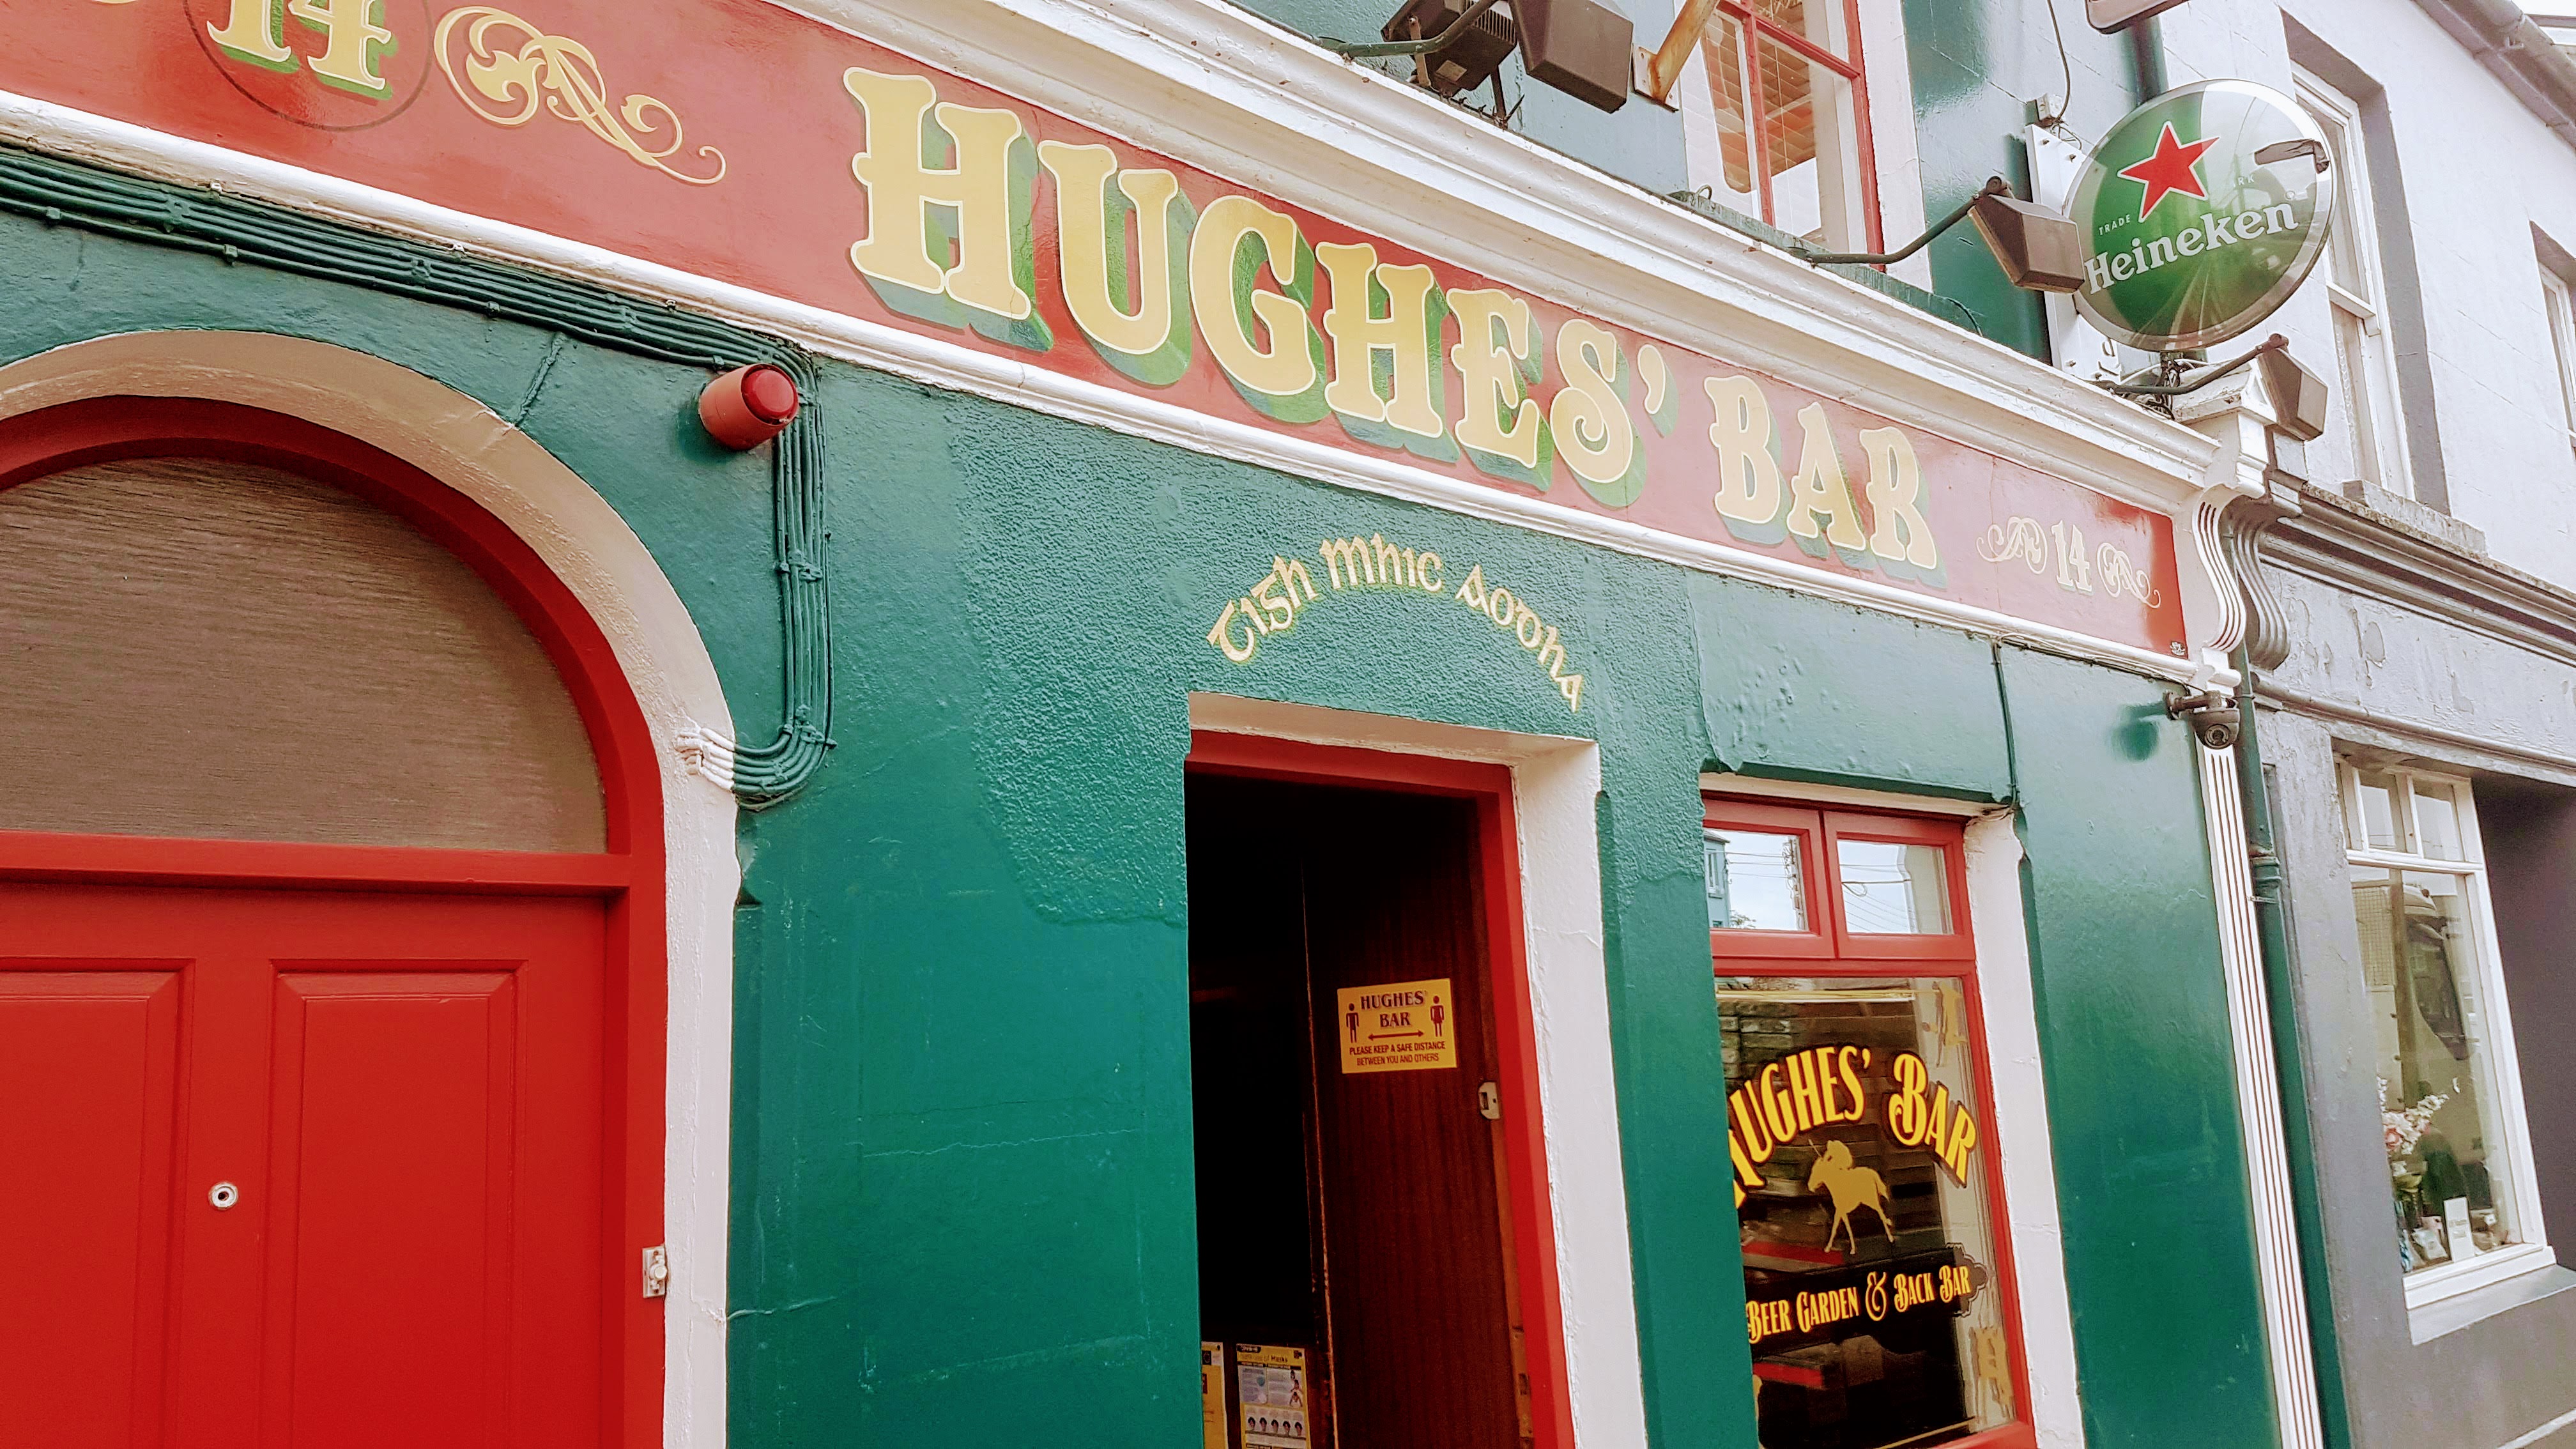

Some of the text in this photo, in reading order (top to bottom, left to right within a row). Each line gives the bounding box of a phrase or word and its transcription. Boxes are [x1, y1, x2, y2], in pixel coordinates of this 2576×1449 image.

[2098, 214, 2131, 236] TRADE
[2083, 203, 2299, 295] Heineken
[843, 66, 1937, 570] HUGHES' BAR
[2051, 519, 2092, 592] 14
[1379, 1011, 1411, 1028] BAR
[1349, 1041, 1446, 1055] PLEASE KEEP A SAFE DISTANCE
[1356, 1052, 1439, 1066] BETWEEN YOU AND OTHERS
[1865, 1271, 1887, 1322] &
